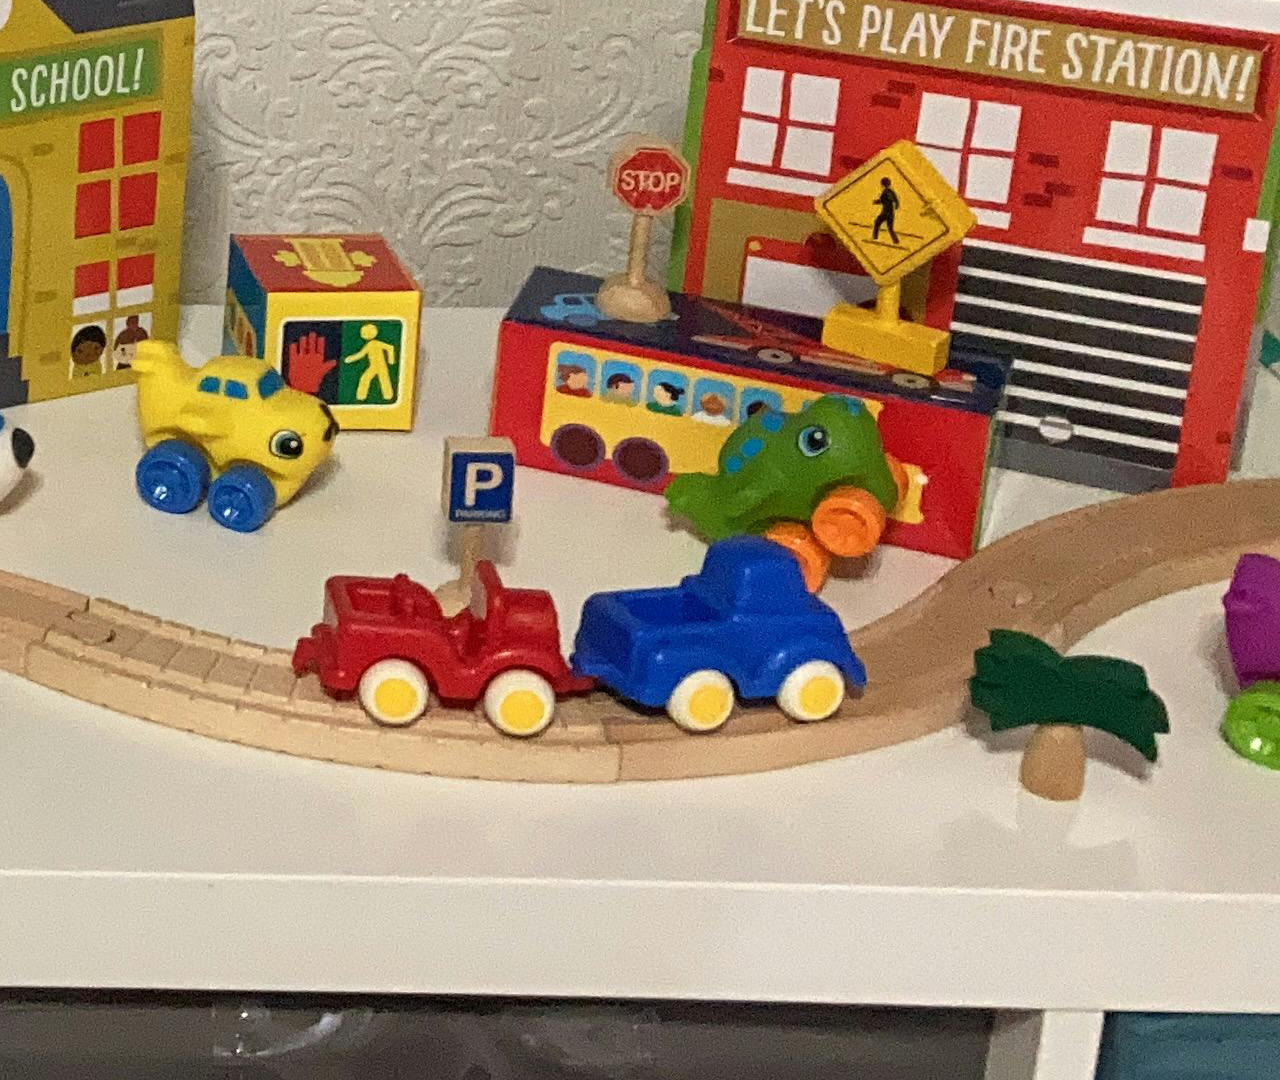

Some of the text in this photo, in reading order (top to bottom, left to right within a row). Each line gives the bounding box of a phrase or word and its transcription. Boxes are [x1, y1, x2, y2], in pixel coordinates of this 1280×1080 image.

[10, 47, 145, 113] SCHOOL!
[858, 4, 956, 60] PLAY
[965, 17, 1053, 75] FIRE
[1061, 31, 1255, 103] STATION!
[621, 169, 680, 194] STOP
[464, 461, 503, 508] P
